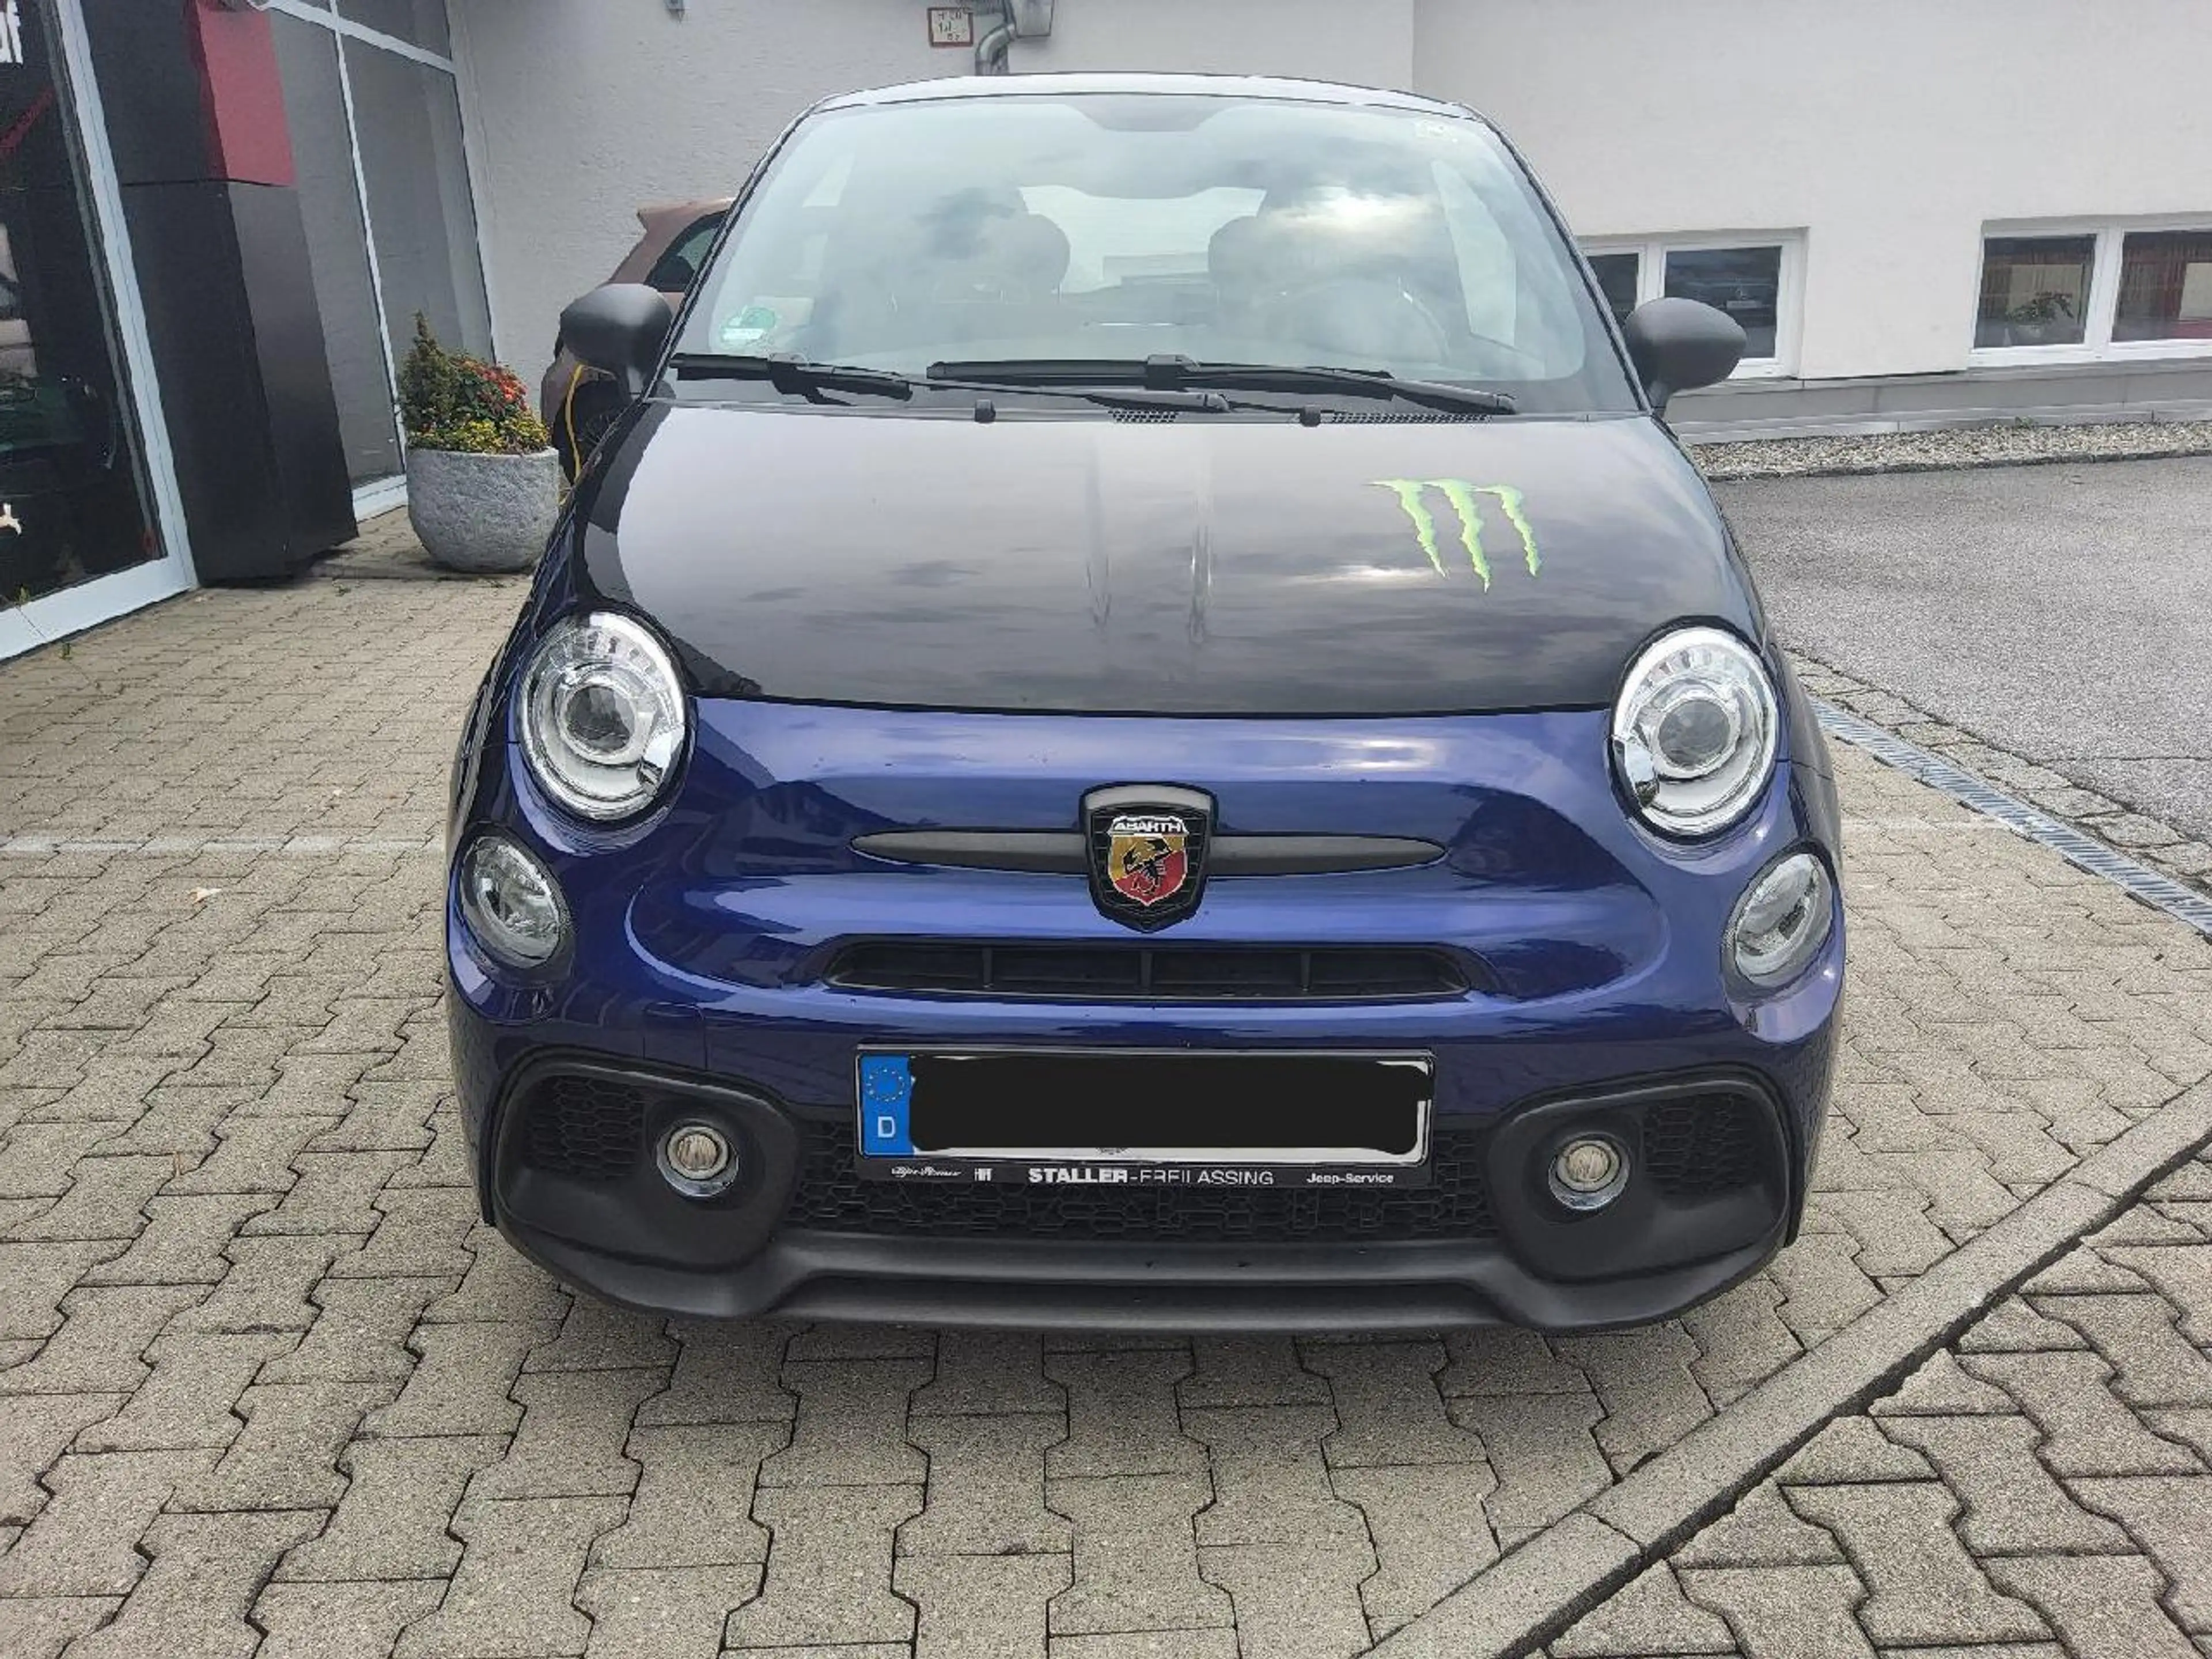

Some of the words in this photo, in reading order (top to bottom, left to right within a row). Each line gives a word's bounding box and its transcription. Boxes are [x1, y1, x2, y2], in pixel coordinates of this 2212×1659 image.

[1114, 821, 1181, 833] ABARTH
[877, 1116, 896, 1138] D
[1306, 1172, 1394, 1184] Jeep-Service
